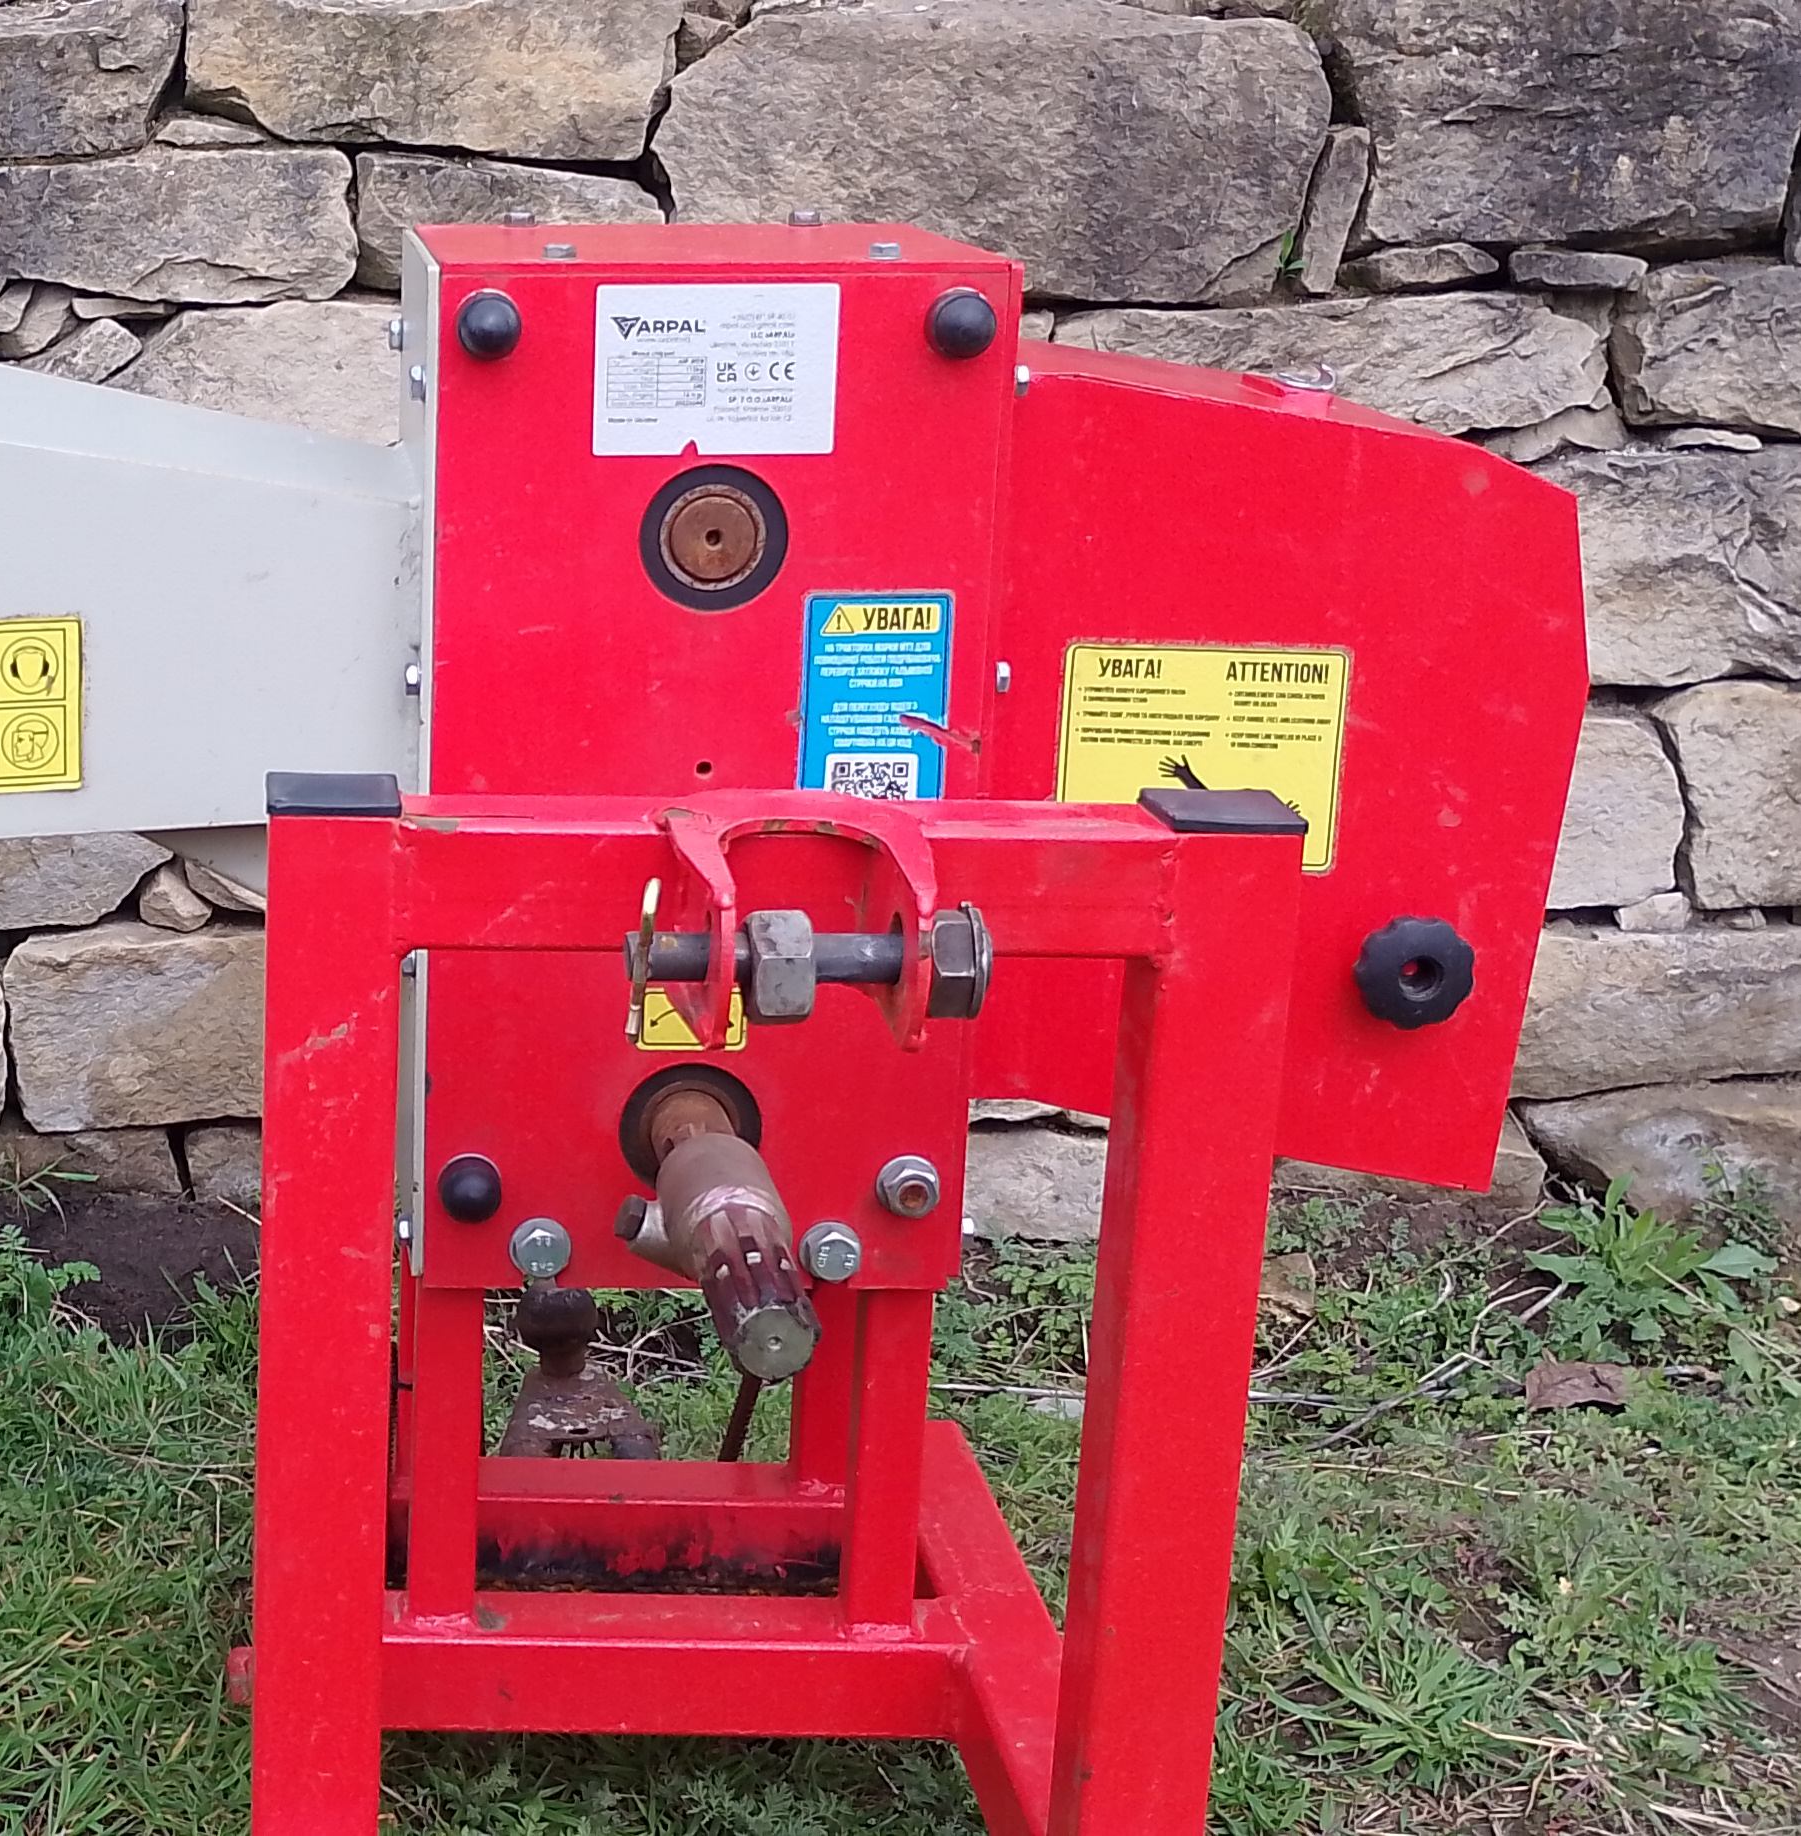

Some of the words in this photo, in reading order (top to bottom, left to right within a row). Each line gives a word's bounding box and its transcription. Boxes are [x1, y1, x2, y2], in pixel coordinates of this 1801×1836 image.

[636, 319, 706, 337] ARPAL
[716, 362, 737, 372] UK
[769, 361, 796, 381] CE
[716, 372, 738, 383] CA
[862, 606, 932, 632] УВАГА!
[1098, 657, 1163, 679] УВАГА!
[1225, 661, 1330, 685] ATTENTION!
